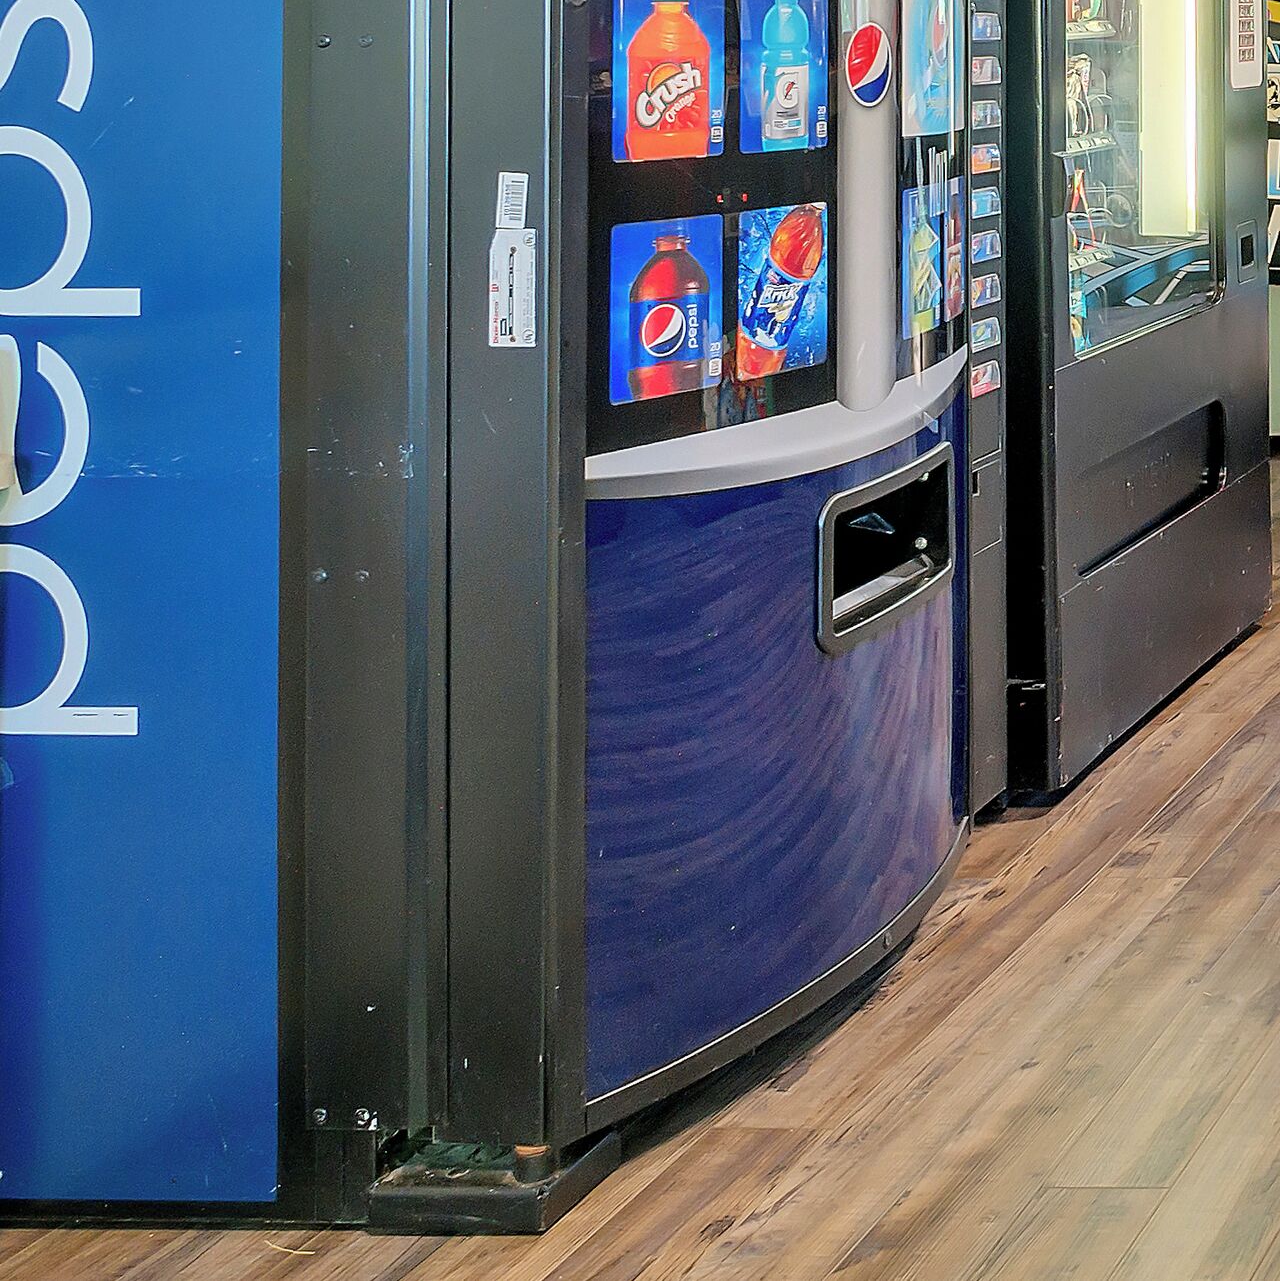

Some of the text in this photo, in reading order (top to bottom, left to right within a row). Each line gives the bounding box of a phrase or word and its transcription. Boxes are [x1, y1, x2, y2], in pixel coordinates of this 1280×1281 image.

[634, 62, 703, 128] Crush
[665, 92, 697, 123] orange
[687, 304, 699, 348] pepsi
